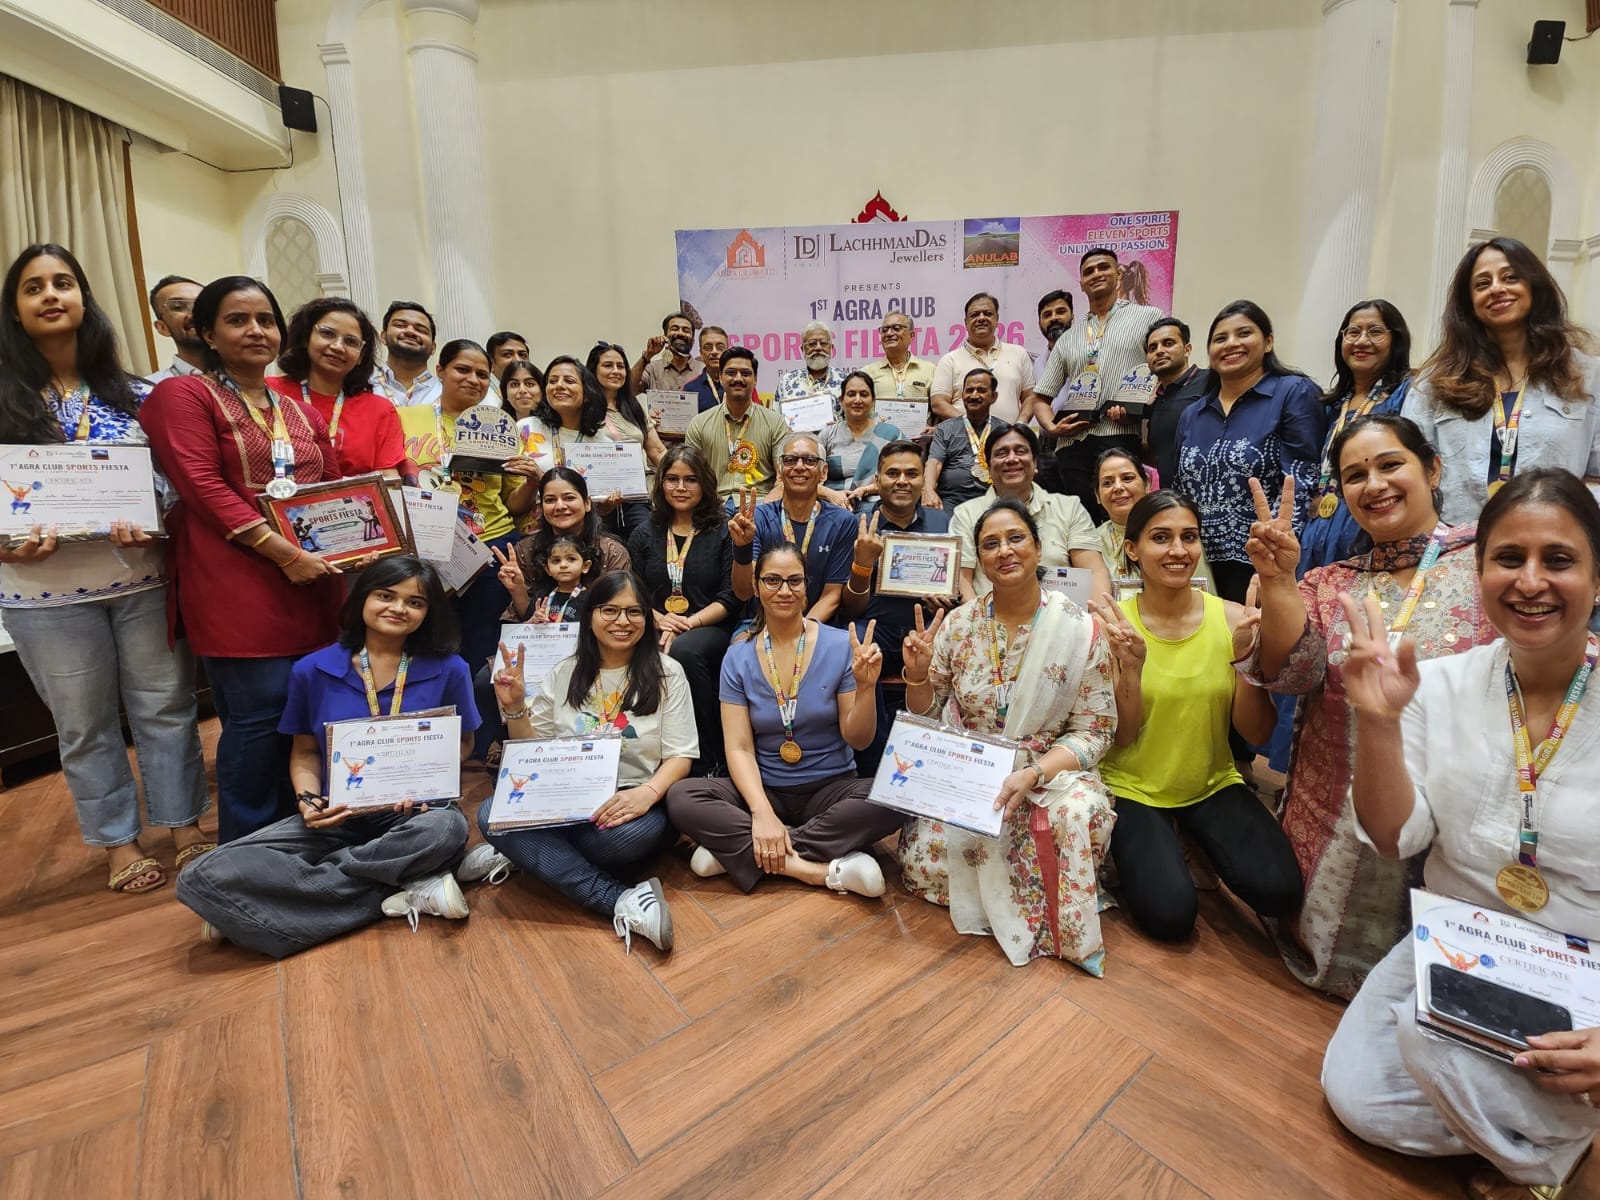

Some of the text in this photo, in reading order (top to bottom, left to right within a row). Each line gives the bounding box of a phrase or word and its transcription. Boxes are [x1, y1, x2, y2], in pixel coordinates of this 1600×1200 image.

[1110, 214, 1169, 226] ONE SPIRIT.
[1088, 227, 1169, 241] ELEVEN SPORTS
[1120, 240, 1168, 251] PASSION.
[890, 251, 944, 264] Jewellers
[964, 252, 1018, 263] ANULAB
[844, 283, 901, 293] PRESENTS
[810, 299, 828, 320] 1ST
[833, 298, 883, 321] AGRA
[1119, 383, 1153, 393] FITNESS
[1068, 391, 1098, 400] FITNESS
[458, 431, 516, 446] FITNESS
[308, 513, 339, 526] SPORTS
[340, 509, 363, 519] FIESTA
[1547, 725, 1562, 745] CLUB
[1555, 701, 1574, 728] SPORTS
[1567, 679, 1585, 704] FIESTA
[1576, 660, 1593, 682] 2026
[911, 742, 928, 750] AGRA
[930, 746, 946, 754] CLUB
[948, 751, 972, 761] SPORTS
[974, 758, 995, 768] FIESTA
[1458, 924, 1491, 940] AGRA
[1496, 934, 1527, 950] CLUB
[1530, 944, 1577, 965] SPORTS
[1499, 954, 1570, 981] CERTIFICATE
